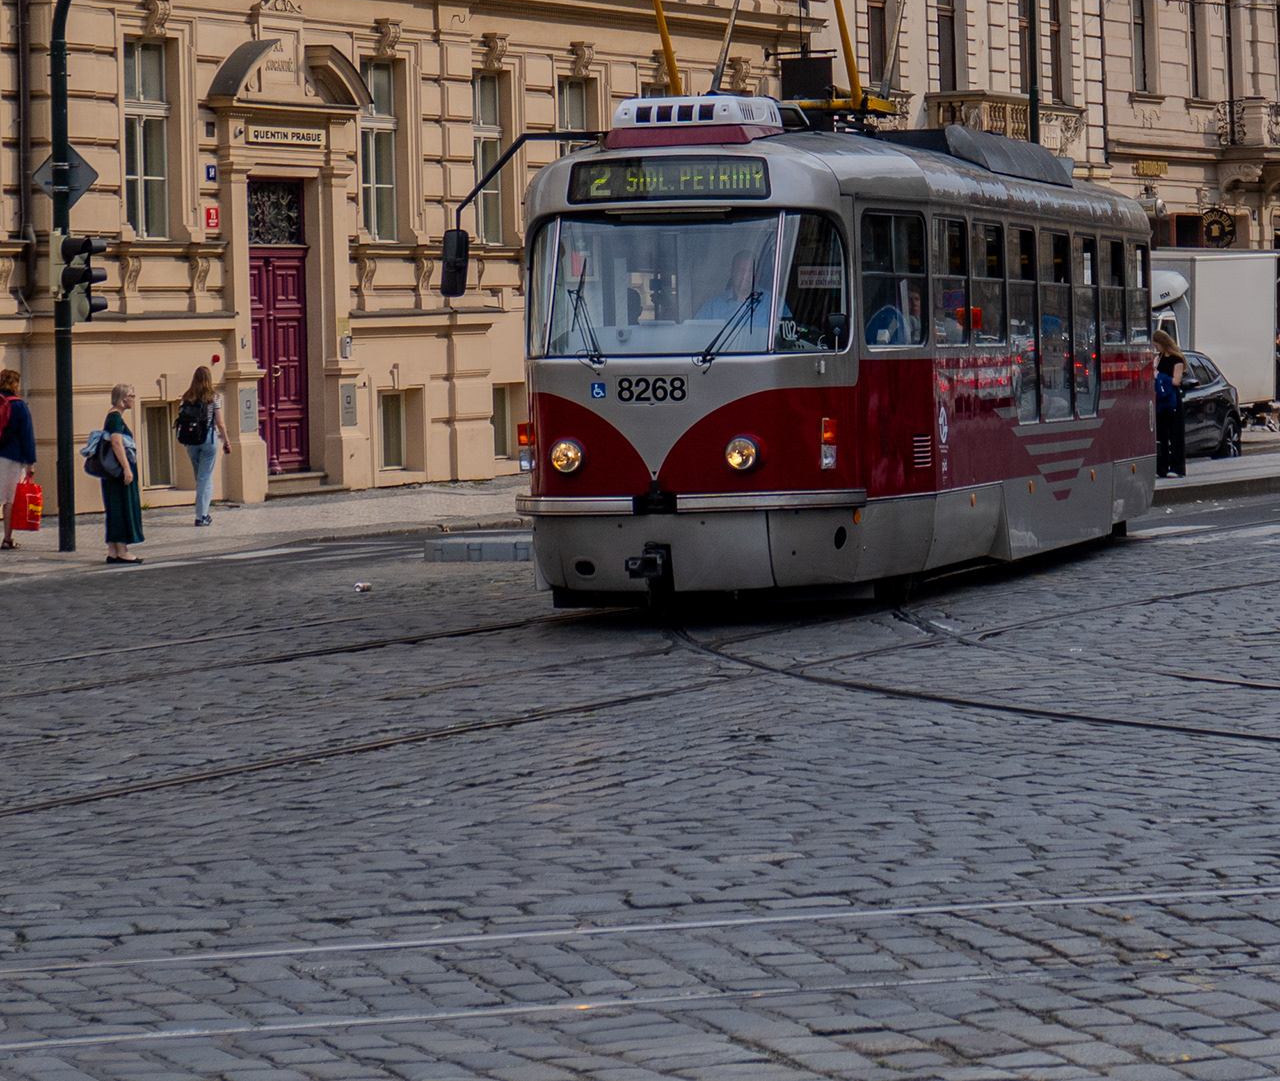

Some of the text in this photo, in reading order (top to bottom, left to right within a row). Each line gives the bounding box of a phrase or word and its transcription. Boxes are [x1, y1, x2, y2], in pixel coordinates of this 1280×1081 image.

[253, 129, 322, 142] QUENTIN PRAGUE
[590, 166, 612, 196] 2
[617, 377, 687, 402] 8268
